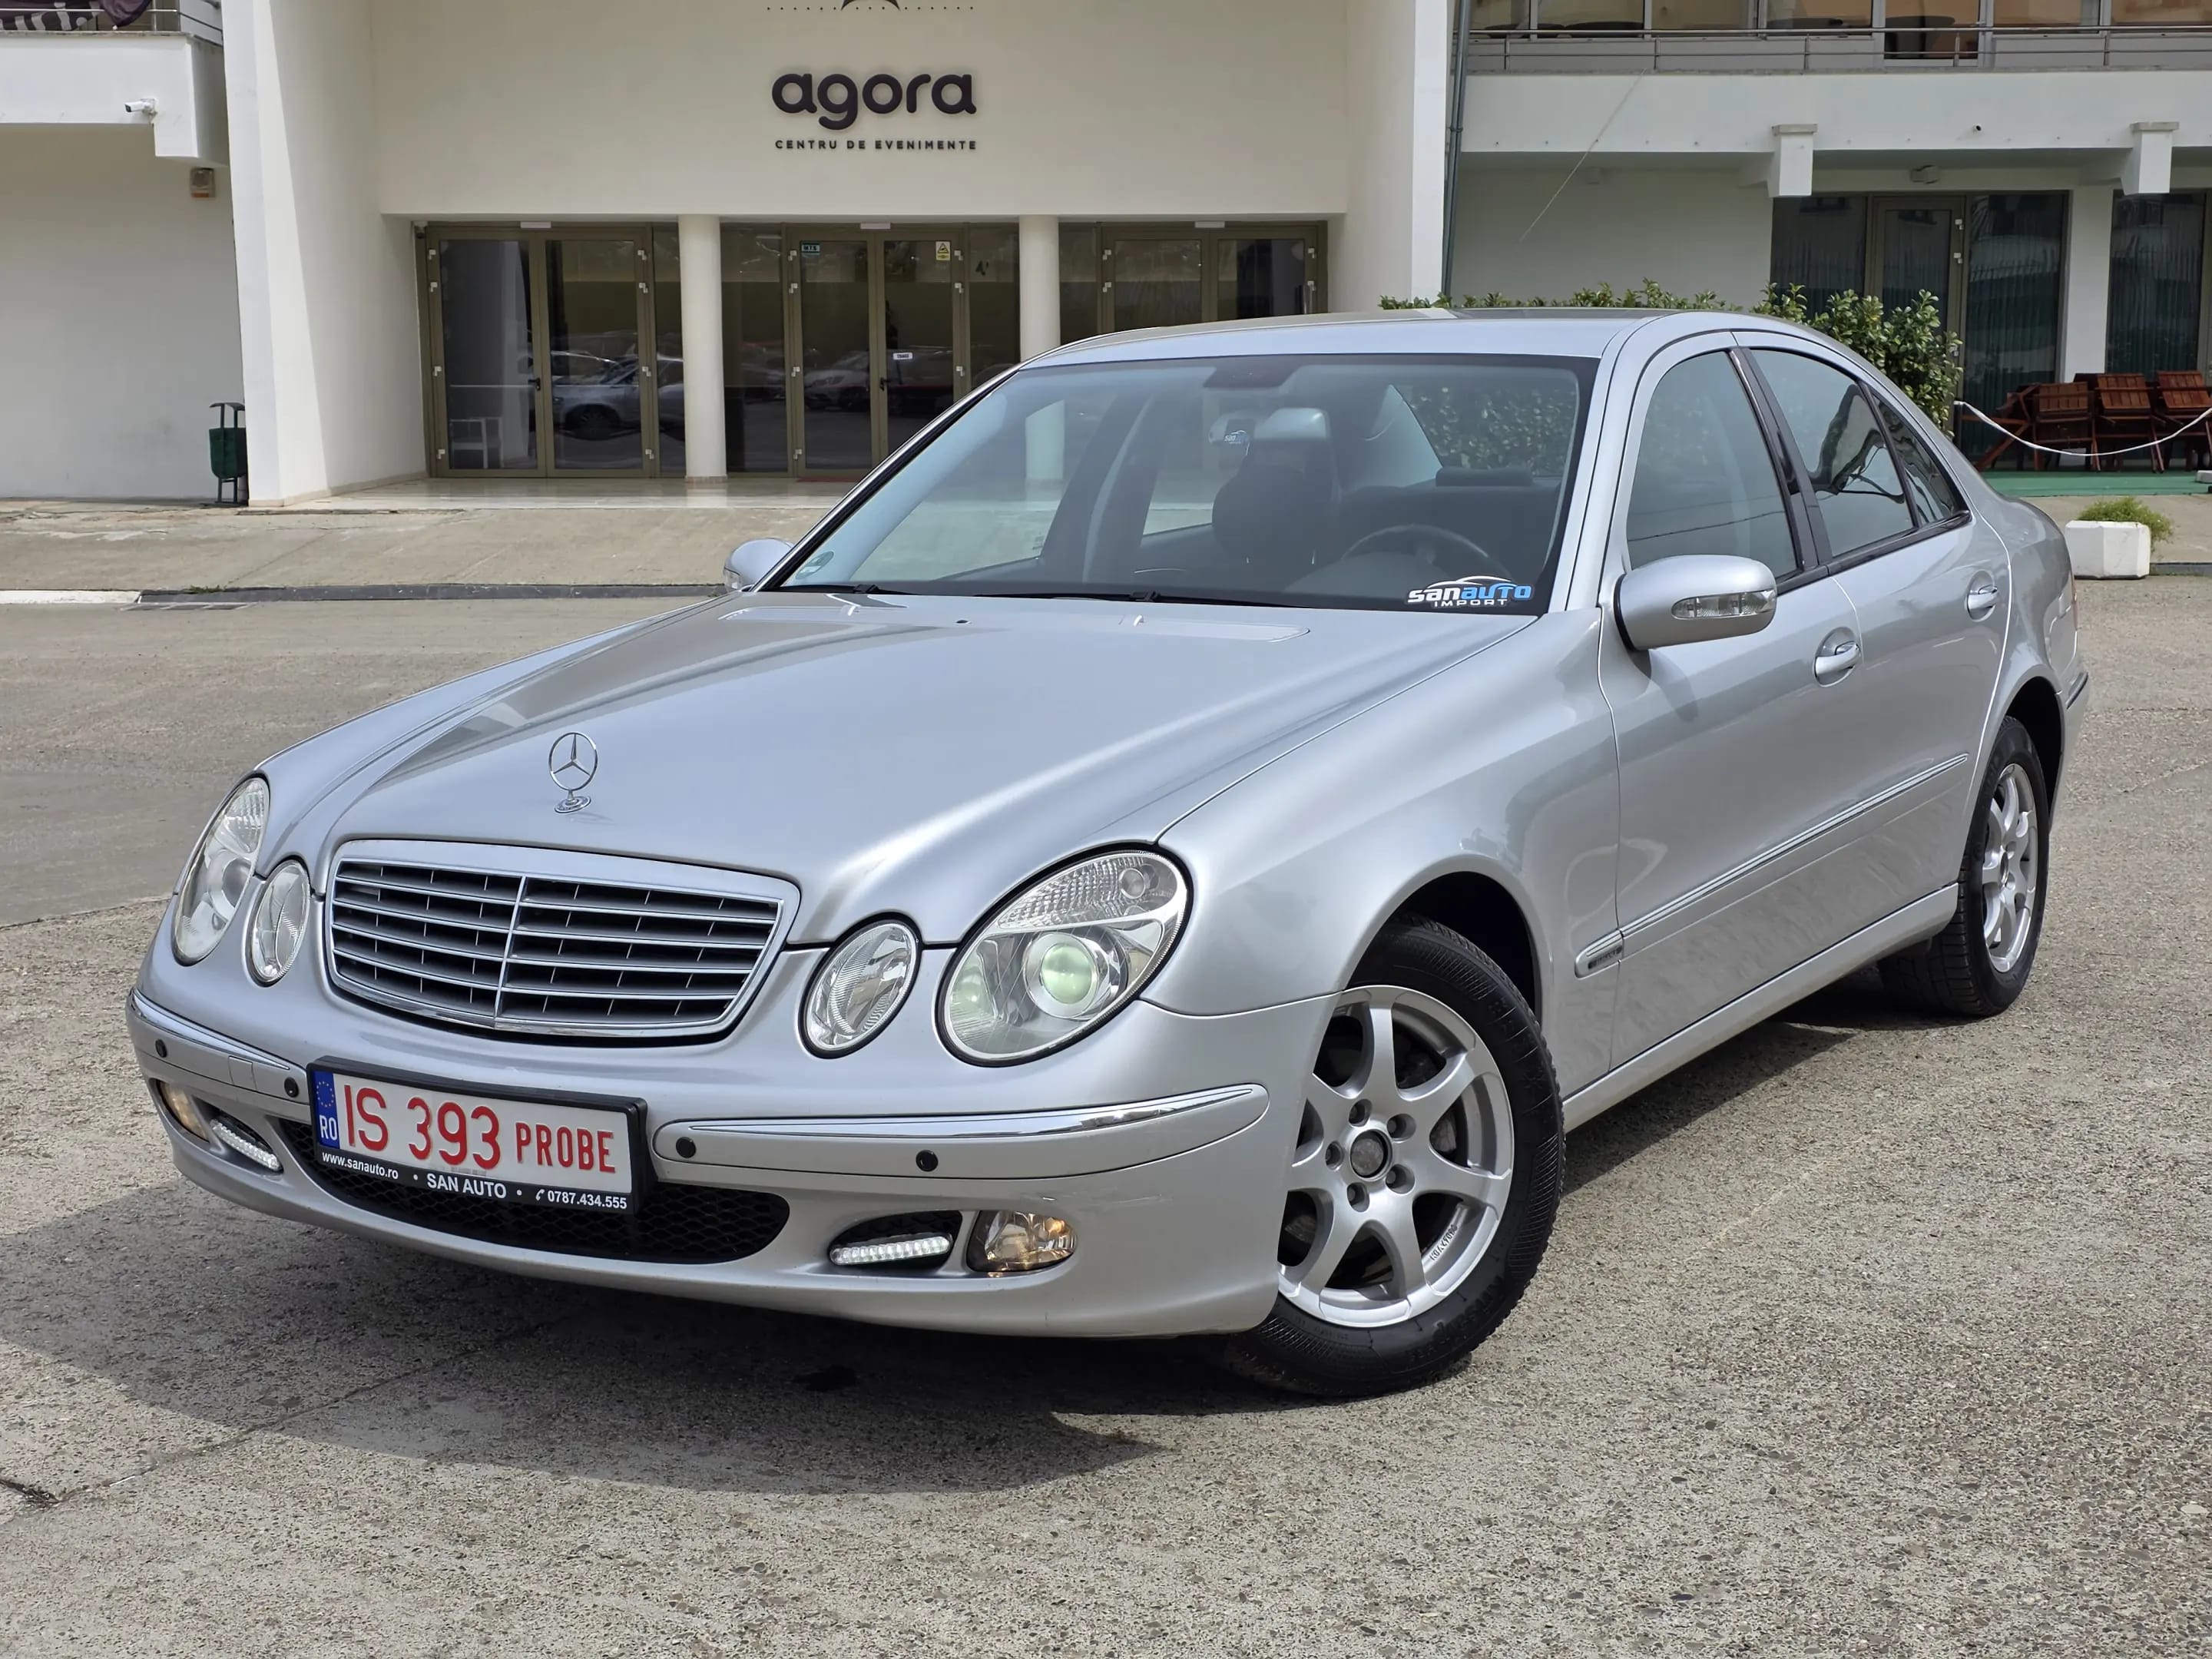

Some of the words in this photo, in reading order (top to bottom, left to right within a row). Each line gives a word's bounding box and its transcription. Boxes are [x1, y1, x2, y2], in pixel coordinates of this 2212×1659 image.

[772, 73, 977, 131] agora
[775, 140, 837, 150] CENTRU
[847, 140, 866, 150] DE
[875, 141, 977, 151] EVENIMENTE
[1434, 598, 1508, 608] IMPORT
[319, 1114, 338, 1141] RO
[343, 1084, 389, 1152] IS
[407, 1096, 501, 1170] 393
[515, 1121, 616, 1174] PROBE
[322, 1151, 399, 1180] www.sanauto.ro
[426, 1173, 459, 1192] SAN
[462, 1178, 507, 1199] AUTO
[547, 1190, 628, 1209] 0787.434.555
